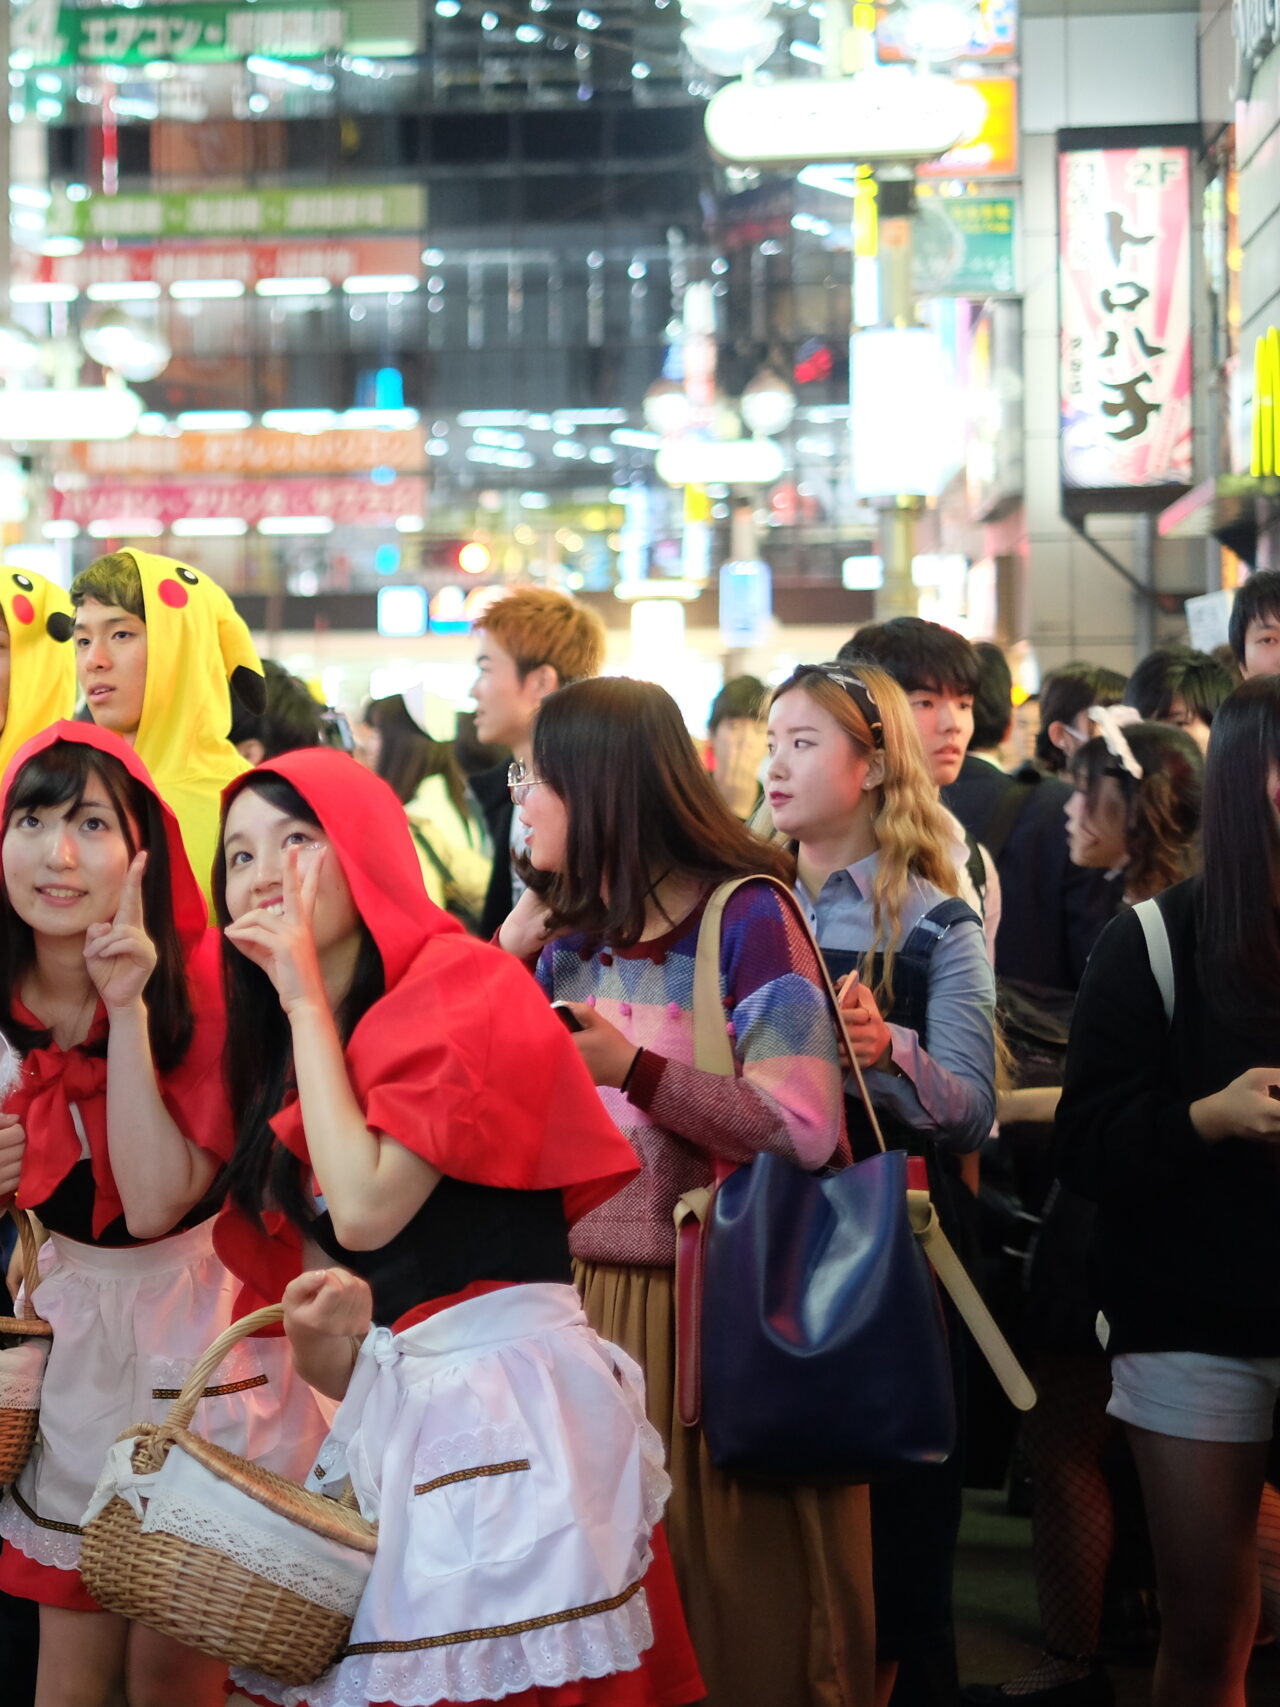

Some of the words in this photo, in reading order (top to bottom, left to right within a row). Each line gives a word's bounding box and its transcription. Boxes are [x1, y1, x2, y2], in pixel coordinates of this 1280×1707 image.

[1132, 160, 1183, 187] 2F
[1098, 210, 1167, 441] トロハチ
